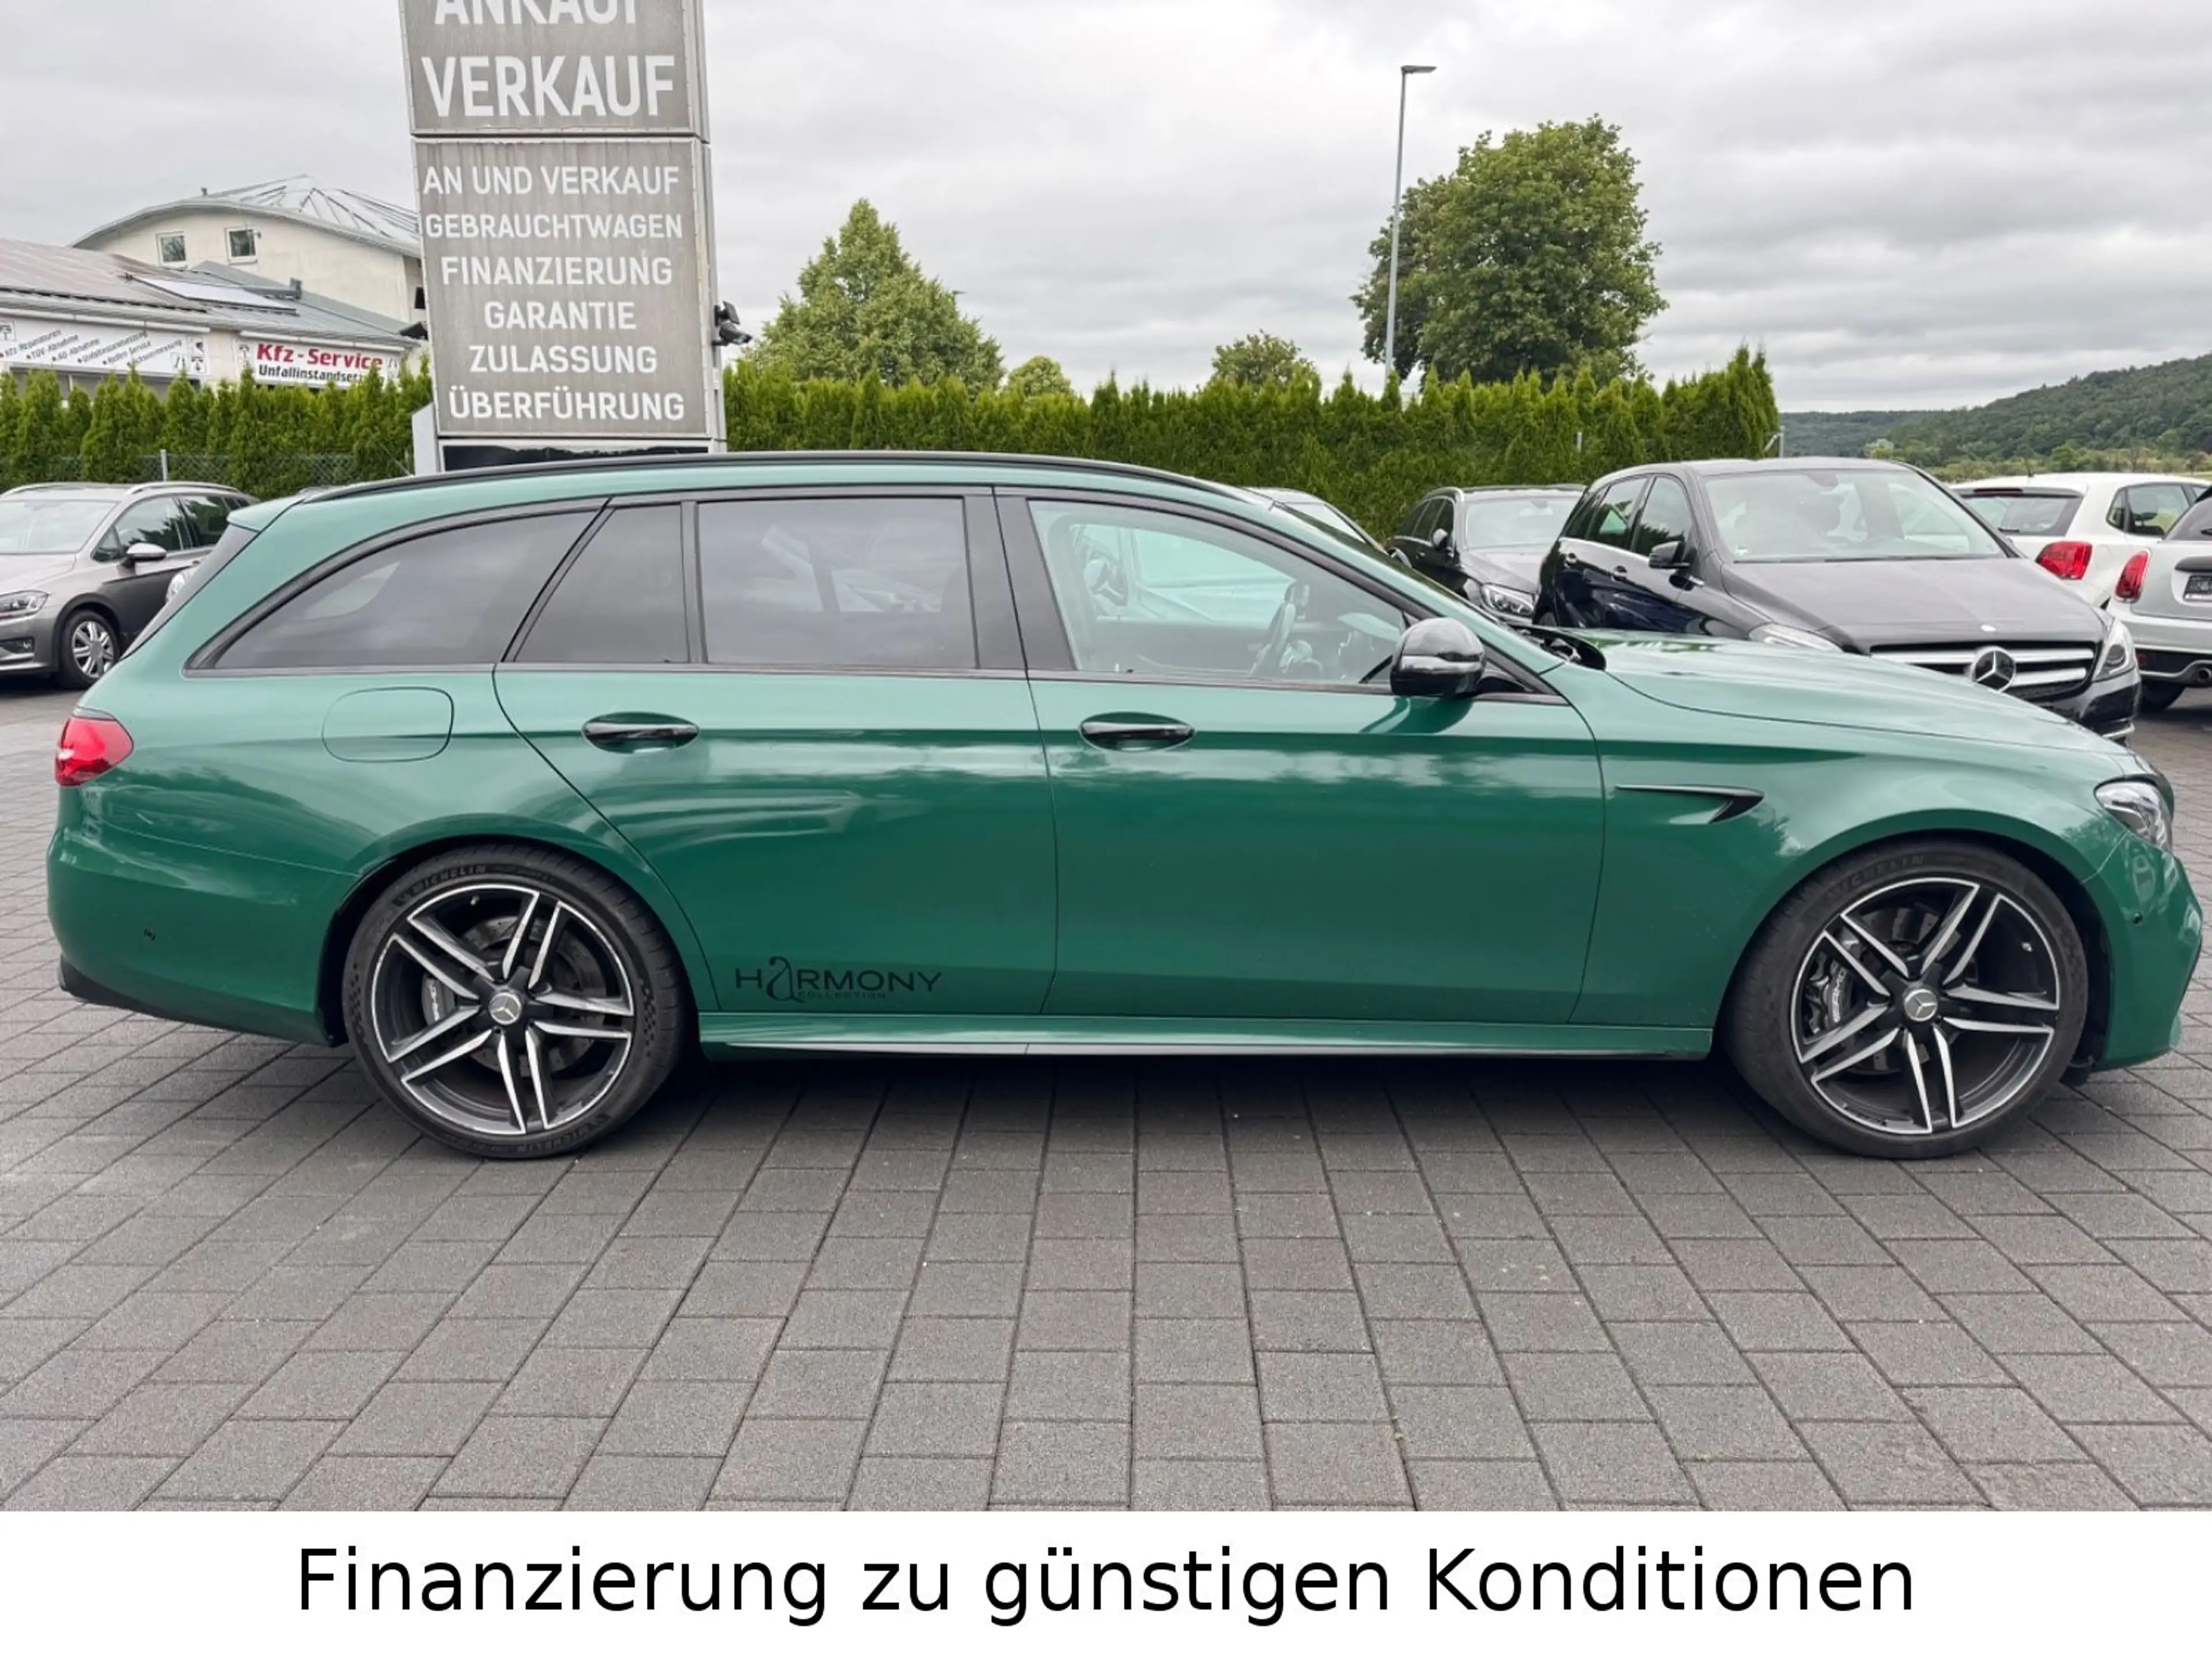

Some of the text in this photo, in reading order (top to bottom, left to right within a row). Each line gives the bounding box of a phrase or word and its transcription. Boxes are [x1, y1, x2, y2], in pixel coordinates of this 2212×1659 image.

[421, 55, 675, 117] VERKAUF
[423, 166, 679, 195] AN UND VERKAUF
[425, 214, 683, 239] GEBRAUCHTWAGEN
[441, 256, 672, 285] FINANZIERUNG
[484, 301, 637, 330] GARANTIE
[469, 346, 657, 374] ZULASSUNG
[449, 385, 684, 421] ÜBERFÜHRUNG
